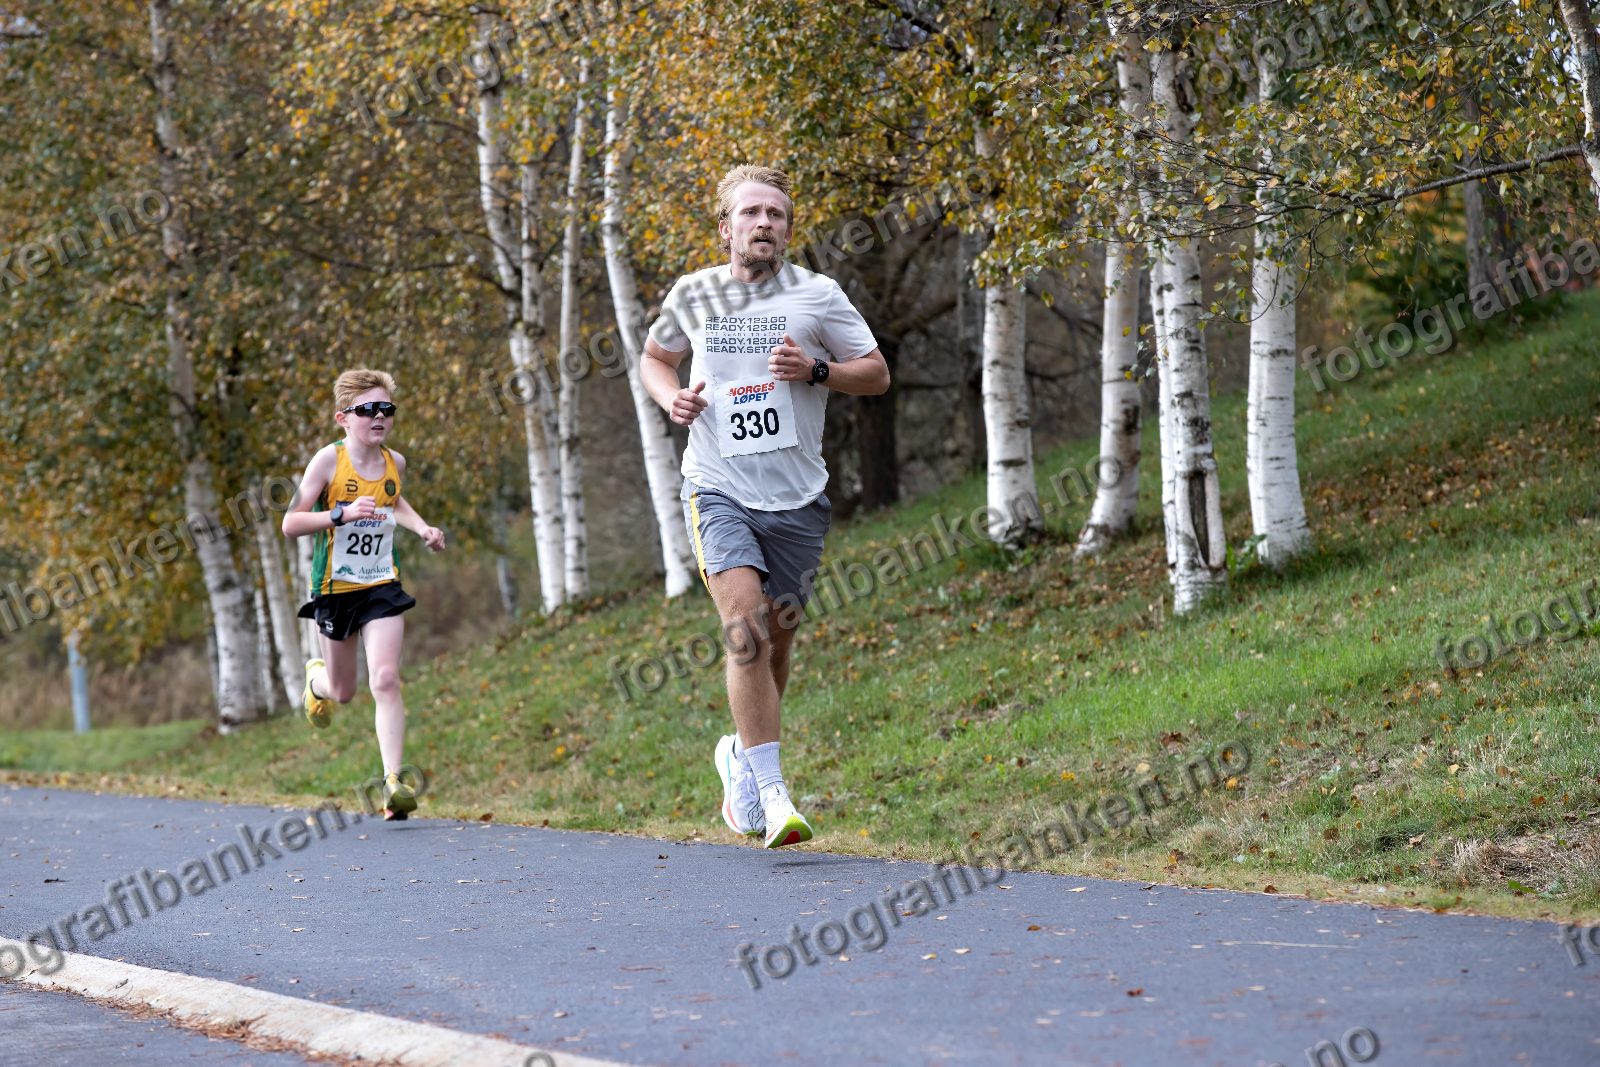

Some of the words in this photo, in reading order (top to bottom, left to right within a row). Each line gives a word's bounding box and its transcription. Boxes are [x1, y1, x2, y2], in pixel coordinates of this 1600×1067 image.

[706, 316, 786, 324] READY.123.GO
[706, 323, 786, 331] READY.123.GO
[706, 337, 784, 345] READY.123.GO
[728, 382, 775, 396] NORGES
[733, 392, 768, 405] LØPET
[730, 408, 779, 440] 330
[354, 520, 382, 528] LØPET
[346, 533, 384, 556] 287
